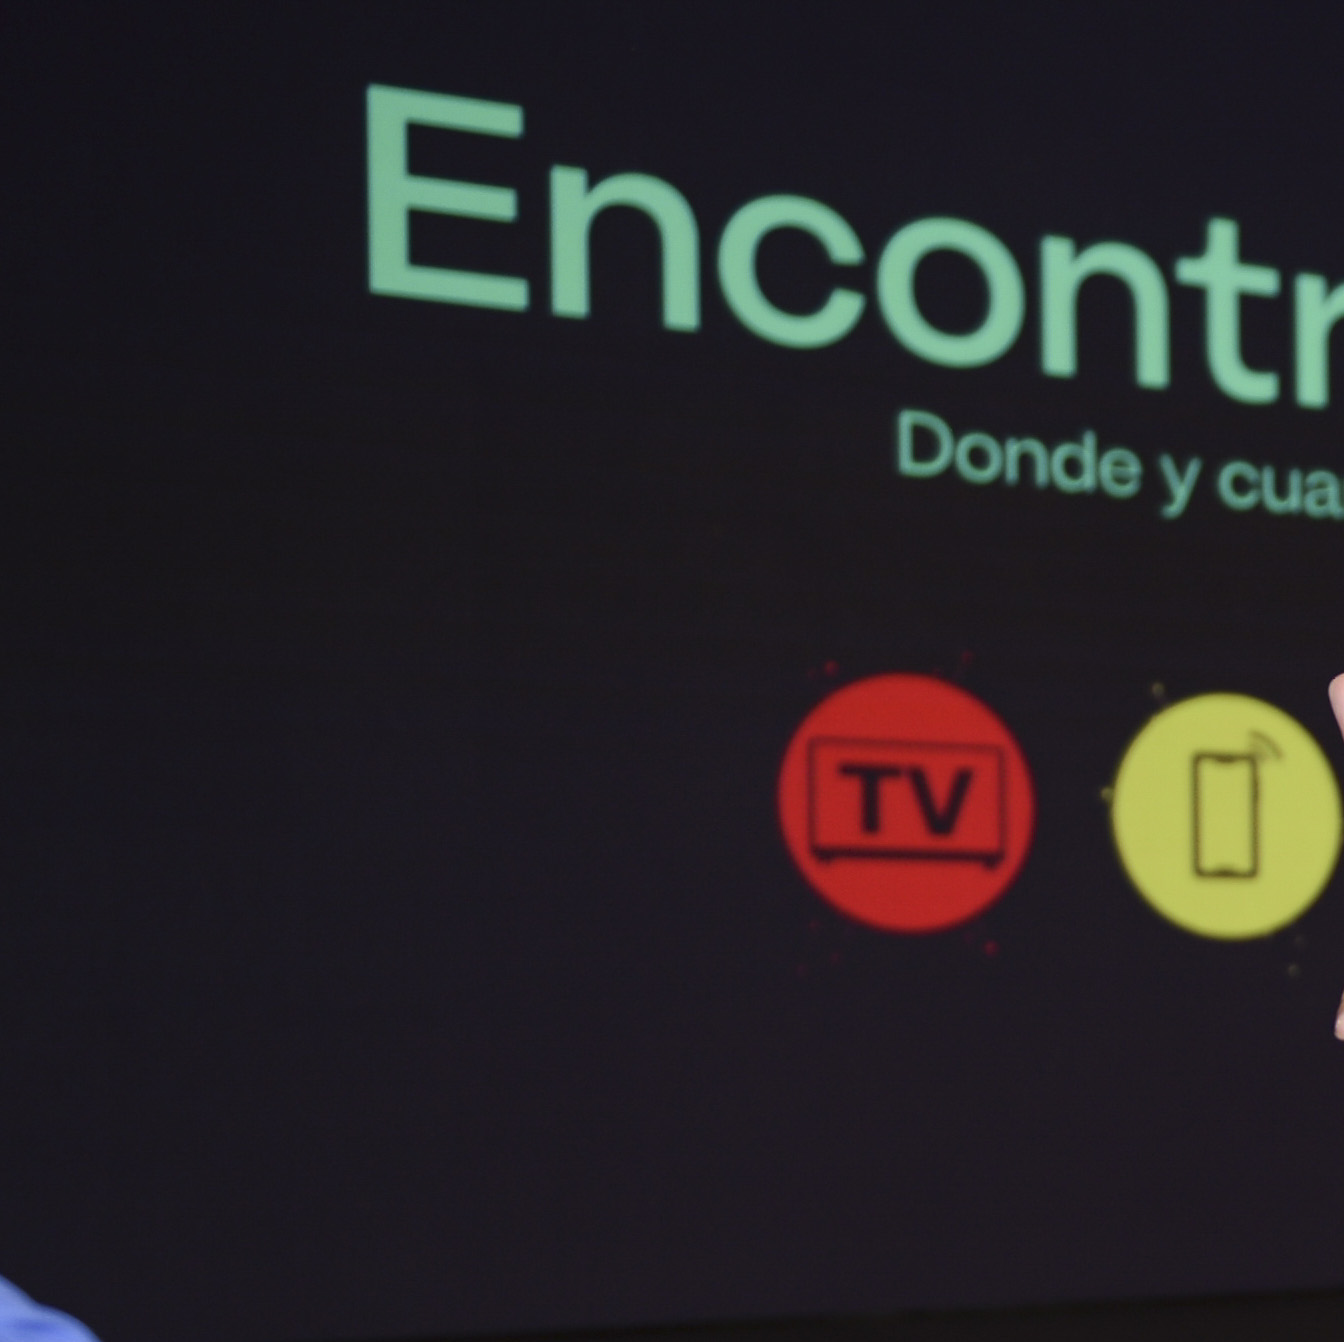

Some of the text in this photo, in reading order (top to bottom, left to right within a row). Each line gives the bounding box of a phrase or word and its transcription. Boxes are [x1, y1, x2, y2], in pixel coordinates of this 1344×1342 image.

[895, 407, 1143, 499] Donde
[1158, 453, 1203, 519] y
[838, 763, 973, 838] TV
